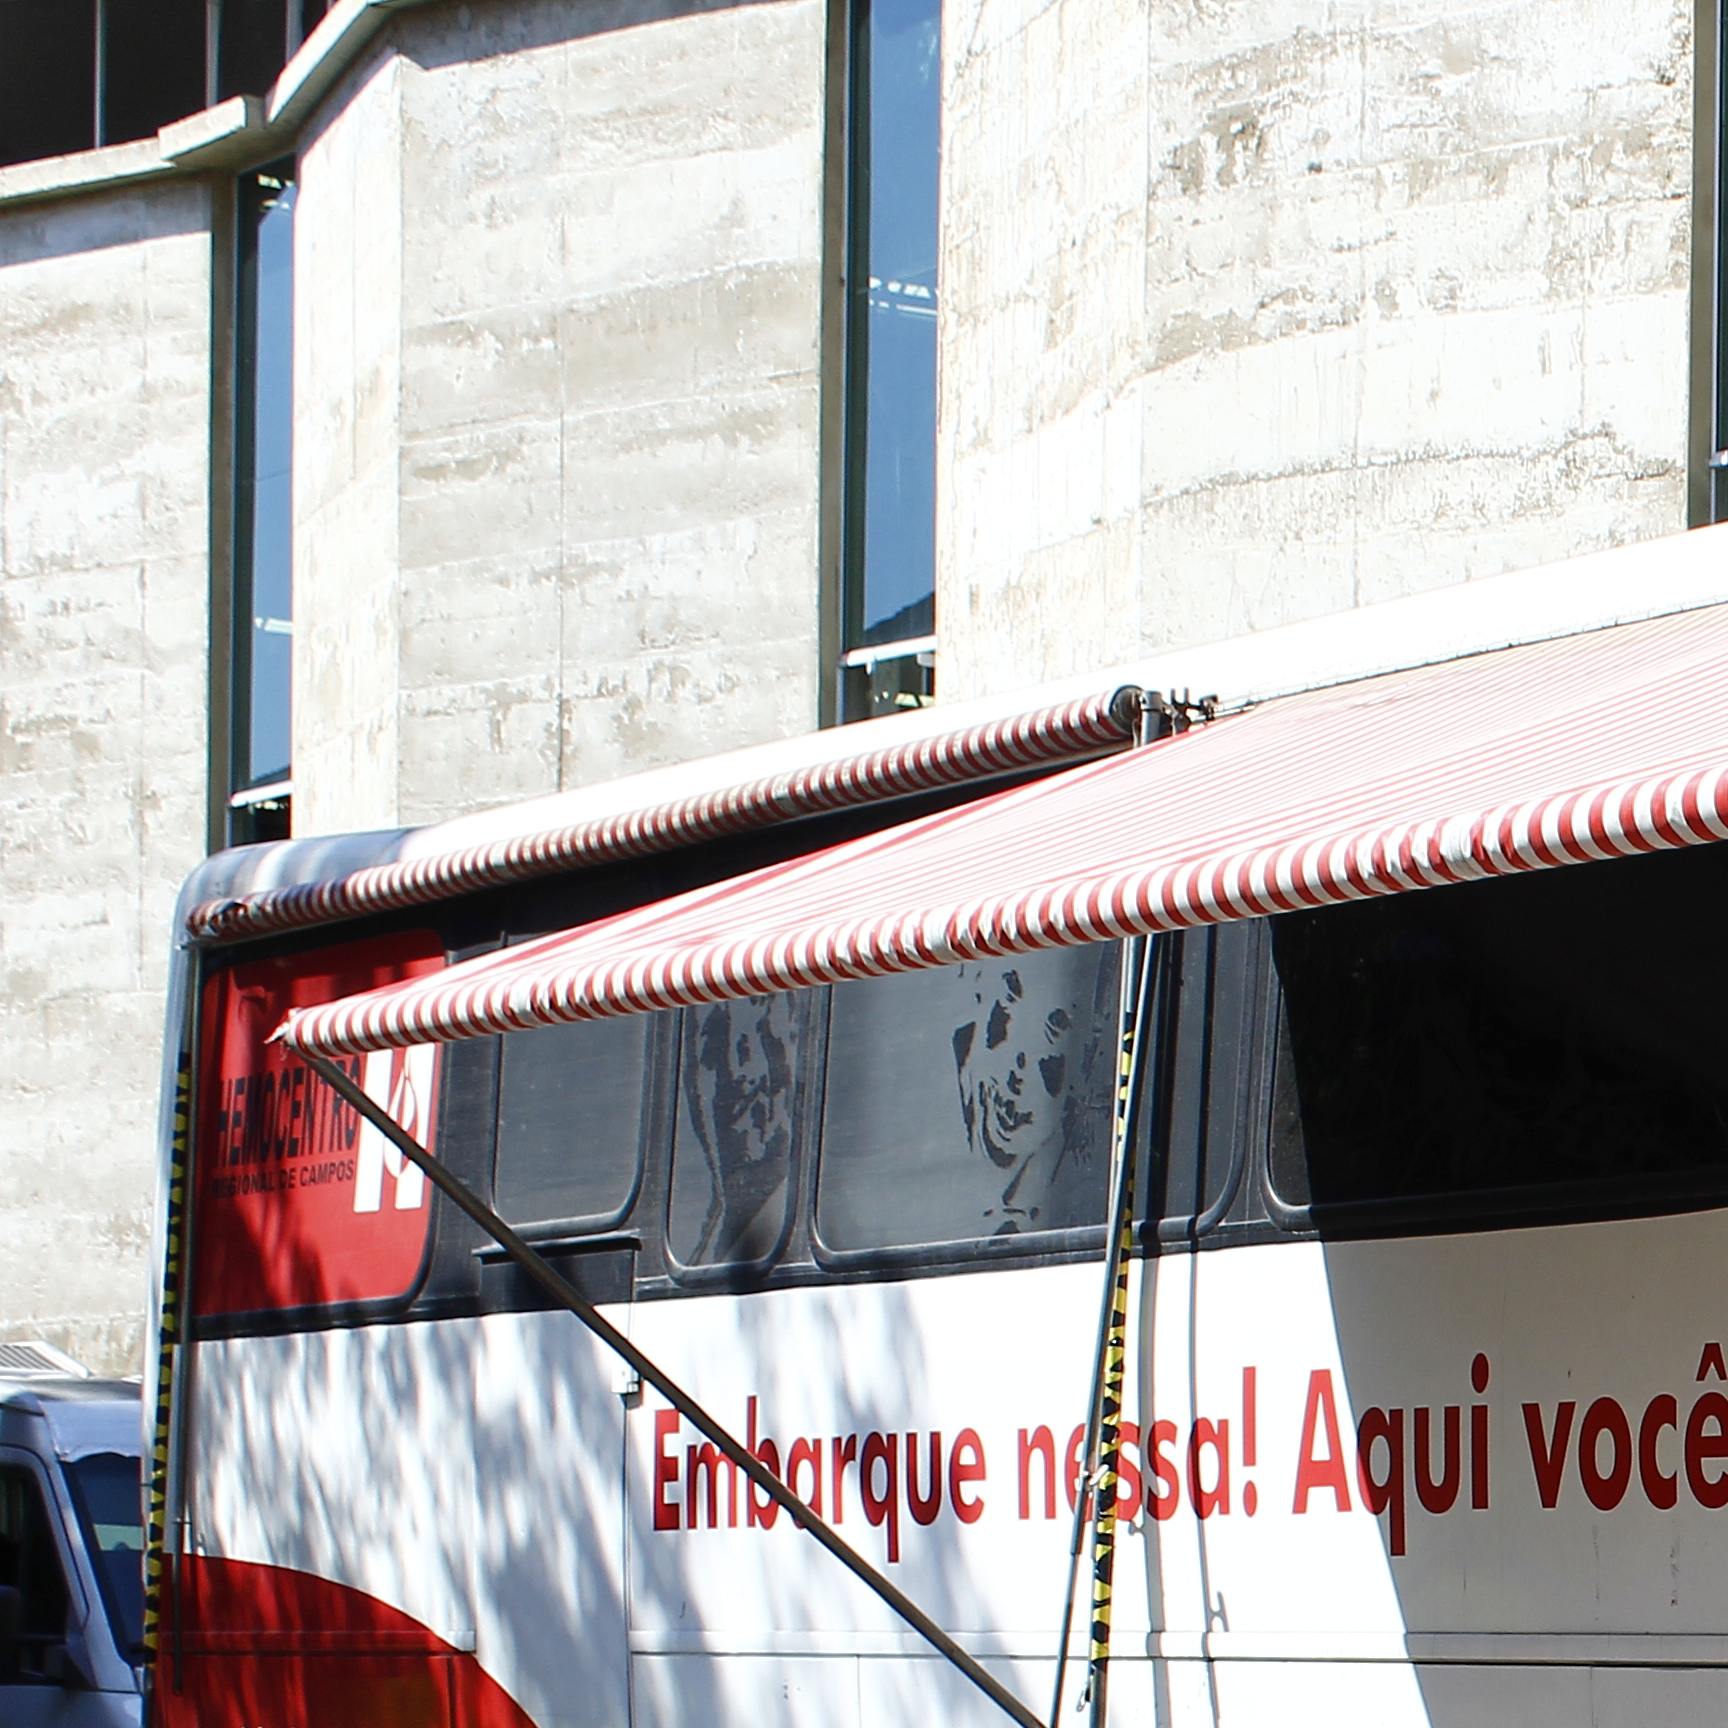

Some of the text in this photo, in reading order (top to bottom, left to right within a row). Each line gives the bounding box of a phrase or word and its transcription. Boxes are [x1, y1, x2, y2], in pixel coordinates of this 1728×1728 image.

[279, 1167, 297, 1190] DE
[300, 1159, 354, 1187] CAMPOS
[653, 1395, 987, 1562] Embarque
[1291, 1352, 1490, 1557] Aqui
